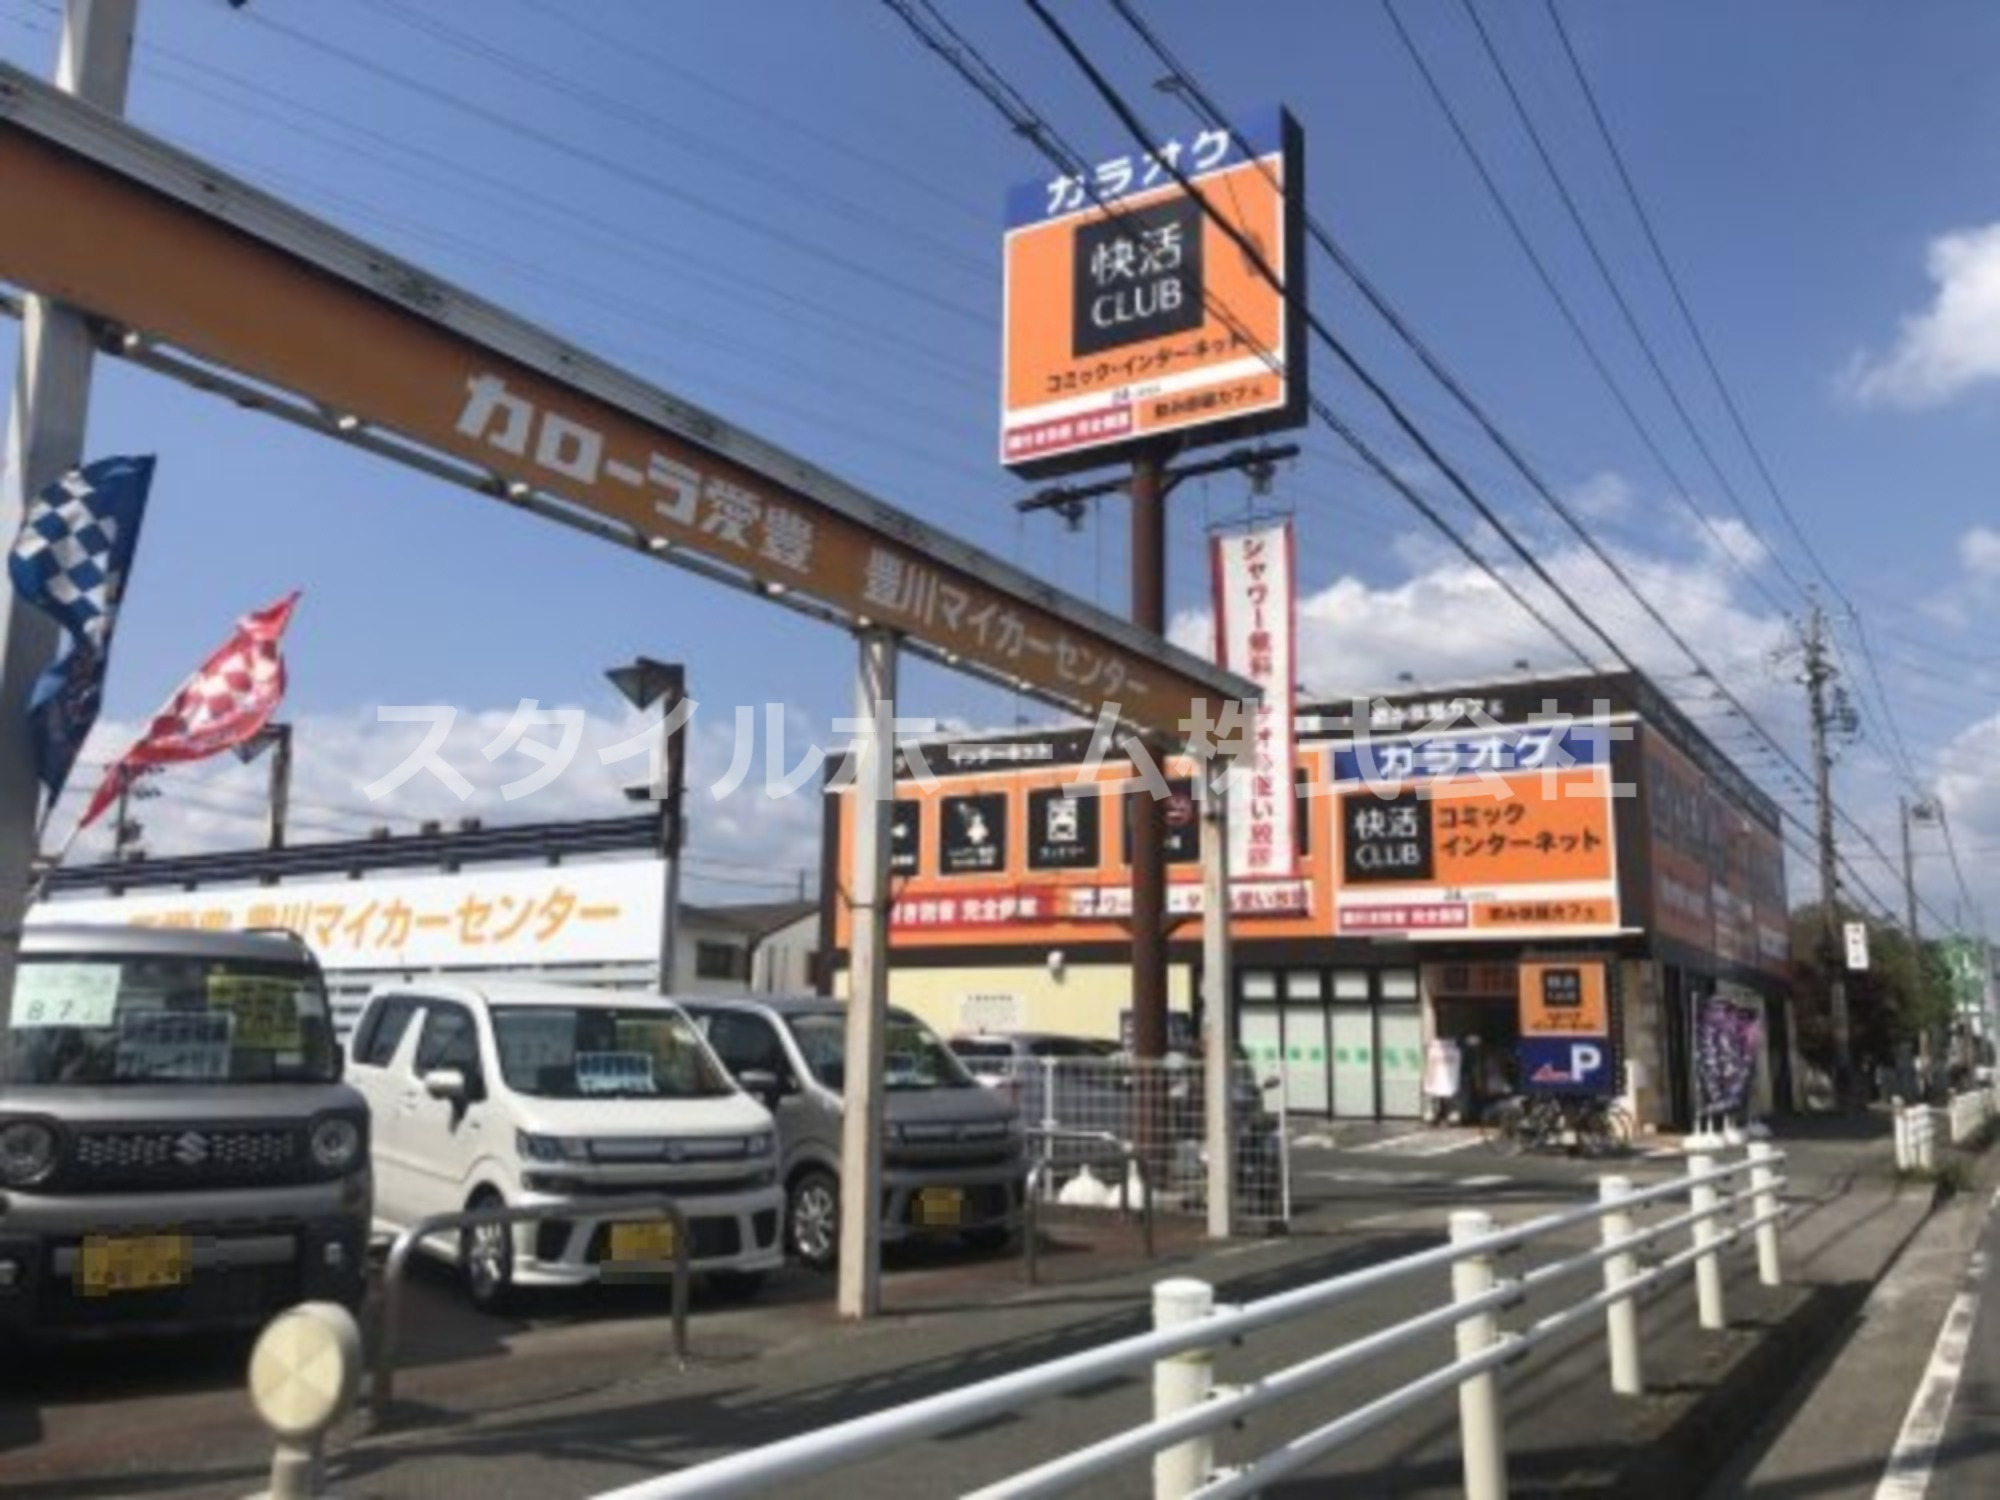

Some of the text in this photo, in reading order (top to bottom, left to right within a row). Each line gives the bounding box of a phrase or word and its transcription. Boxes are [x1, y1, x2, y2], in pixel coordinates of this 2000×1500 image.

[1090, 223, 1181, 285] 快活
[1092, 277, 1182, 326] CLUB
[1355, 806, 1418, 838] 快活
[1437, 803, 1524, 829] コミック
[1355, 845, 1421, 868] CLUB
[1441, 829, 1601, 858] インターネット
[1571, 1044, 1601, 1081] P
